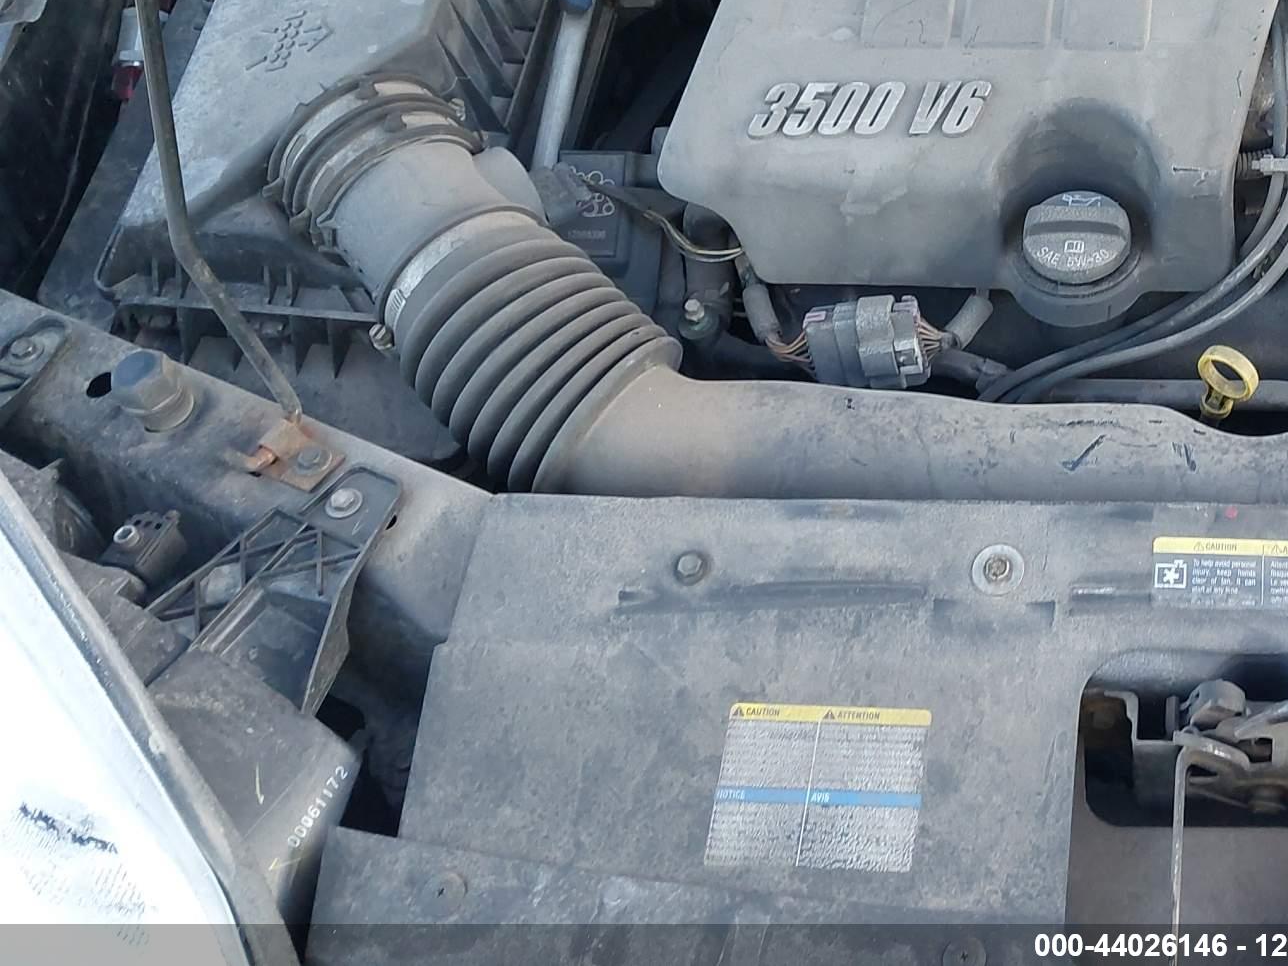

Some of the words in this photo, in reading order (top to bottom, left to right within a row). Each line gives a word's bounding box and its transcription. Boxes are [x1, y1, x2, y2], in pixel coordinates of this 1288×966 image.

[747, 81, 906, 138] 3500
[909, 81, 992, 137] V6
[1036, 246, 1060, 266] SAE
[1067, 249, 1110, 268] 5W-30
[1205, 542, 1238, 552] CAUTION
[746, 707, 780, 716] CAUTION
[837, 710, 881, 720] ATTENTION
[716, 789, 746, 800] NOTICE
[810, 792, 830, 802] AVIS
[287, 765, 348, 848] 00061172
